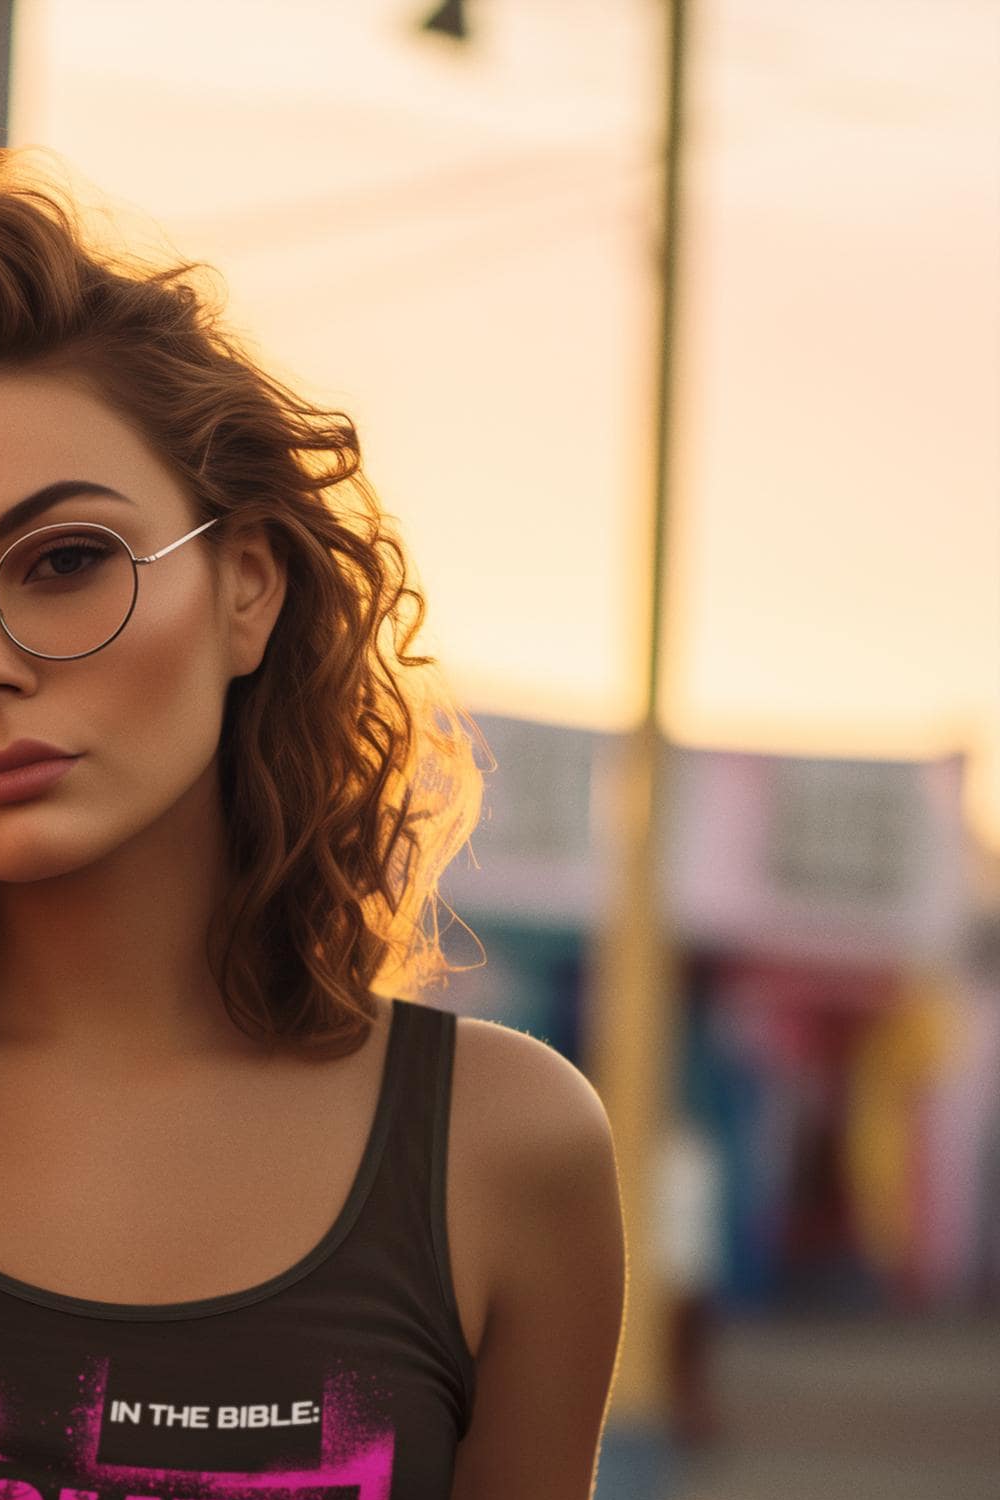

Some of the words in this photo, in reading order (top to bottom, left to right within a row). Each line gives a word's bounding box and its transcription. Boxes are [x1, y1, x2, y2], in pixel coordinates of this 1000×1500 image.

[110, 1400, 141, 1424] IN
[149, 1404, 210, 1428] THE
[217, 1400, 320, 1429] BIBLE:
